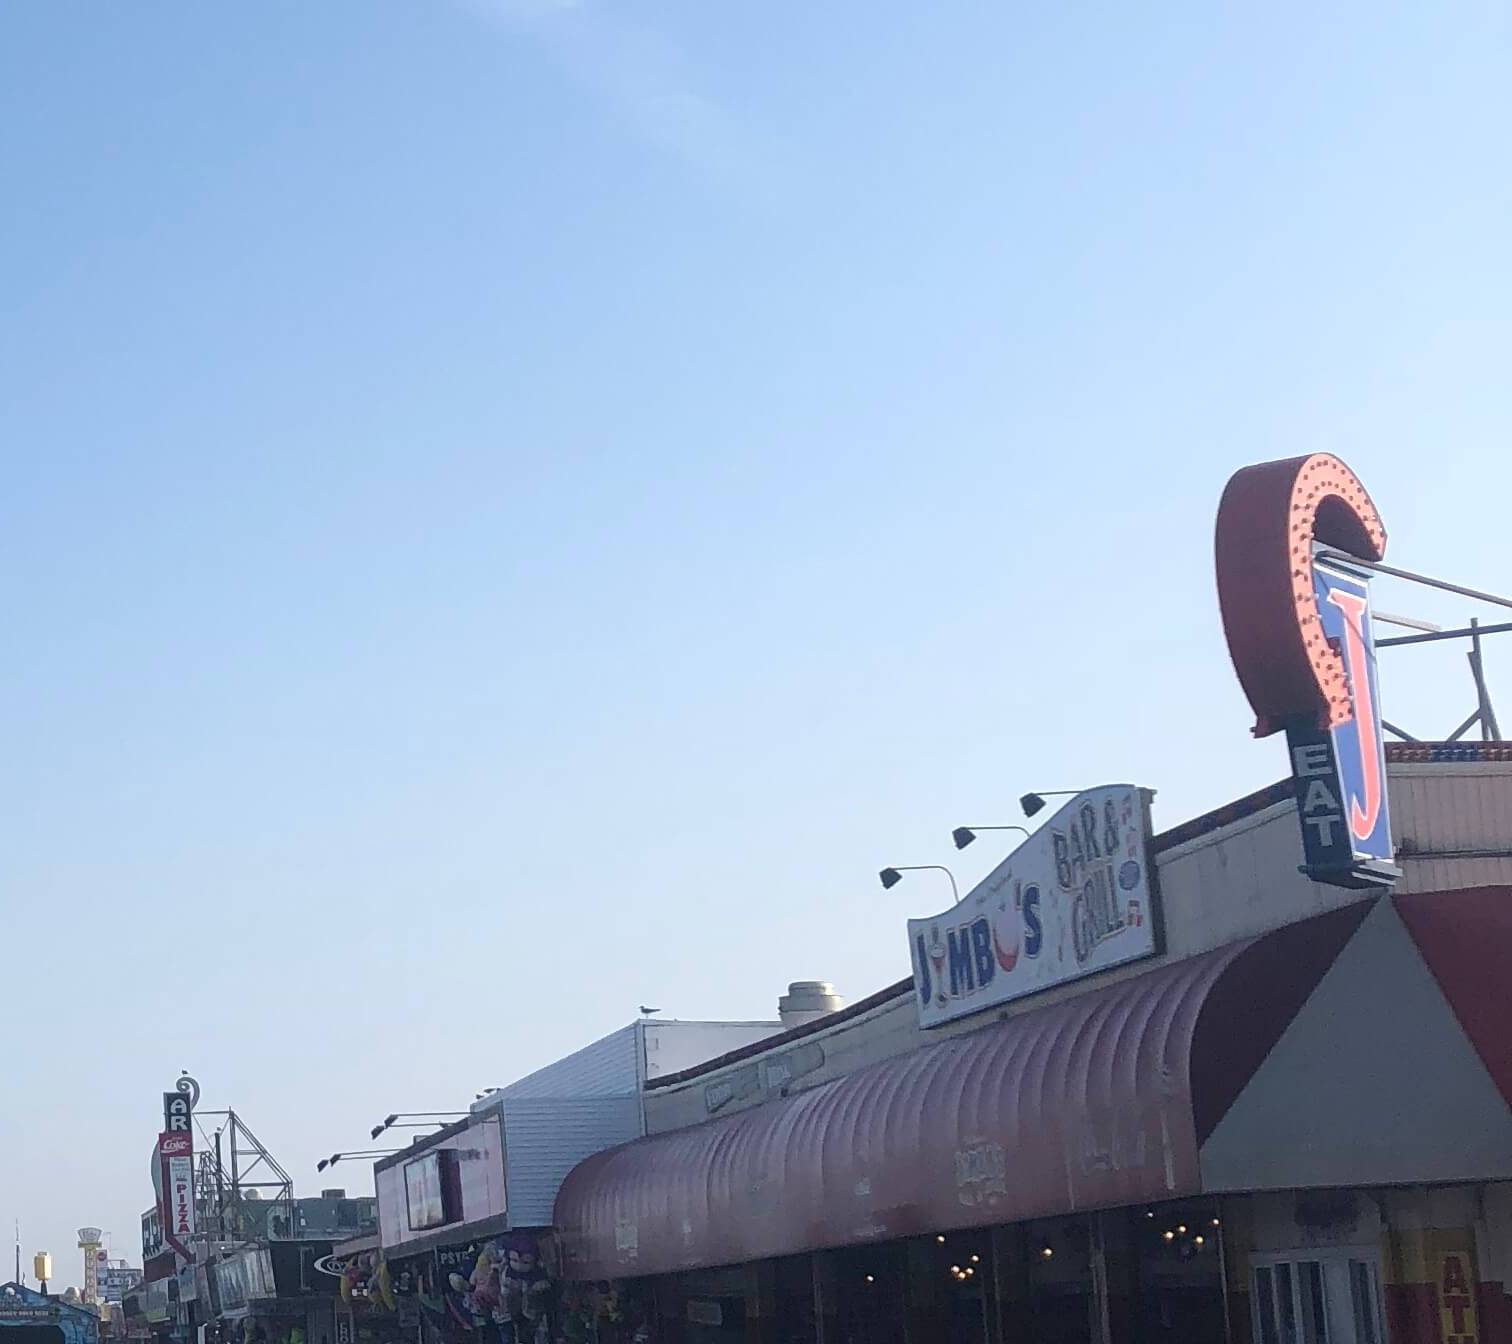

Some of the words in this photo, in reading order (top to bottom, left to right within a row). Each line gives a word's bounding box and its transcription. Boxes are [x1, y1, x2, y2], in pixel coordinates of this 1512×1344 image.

[1292, 743, 1336, 848] EAT
[1050, 799, 1100, 892] BAR
[177, 1183, 191, 1233] PIZZA
